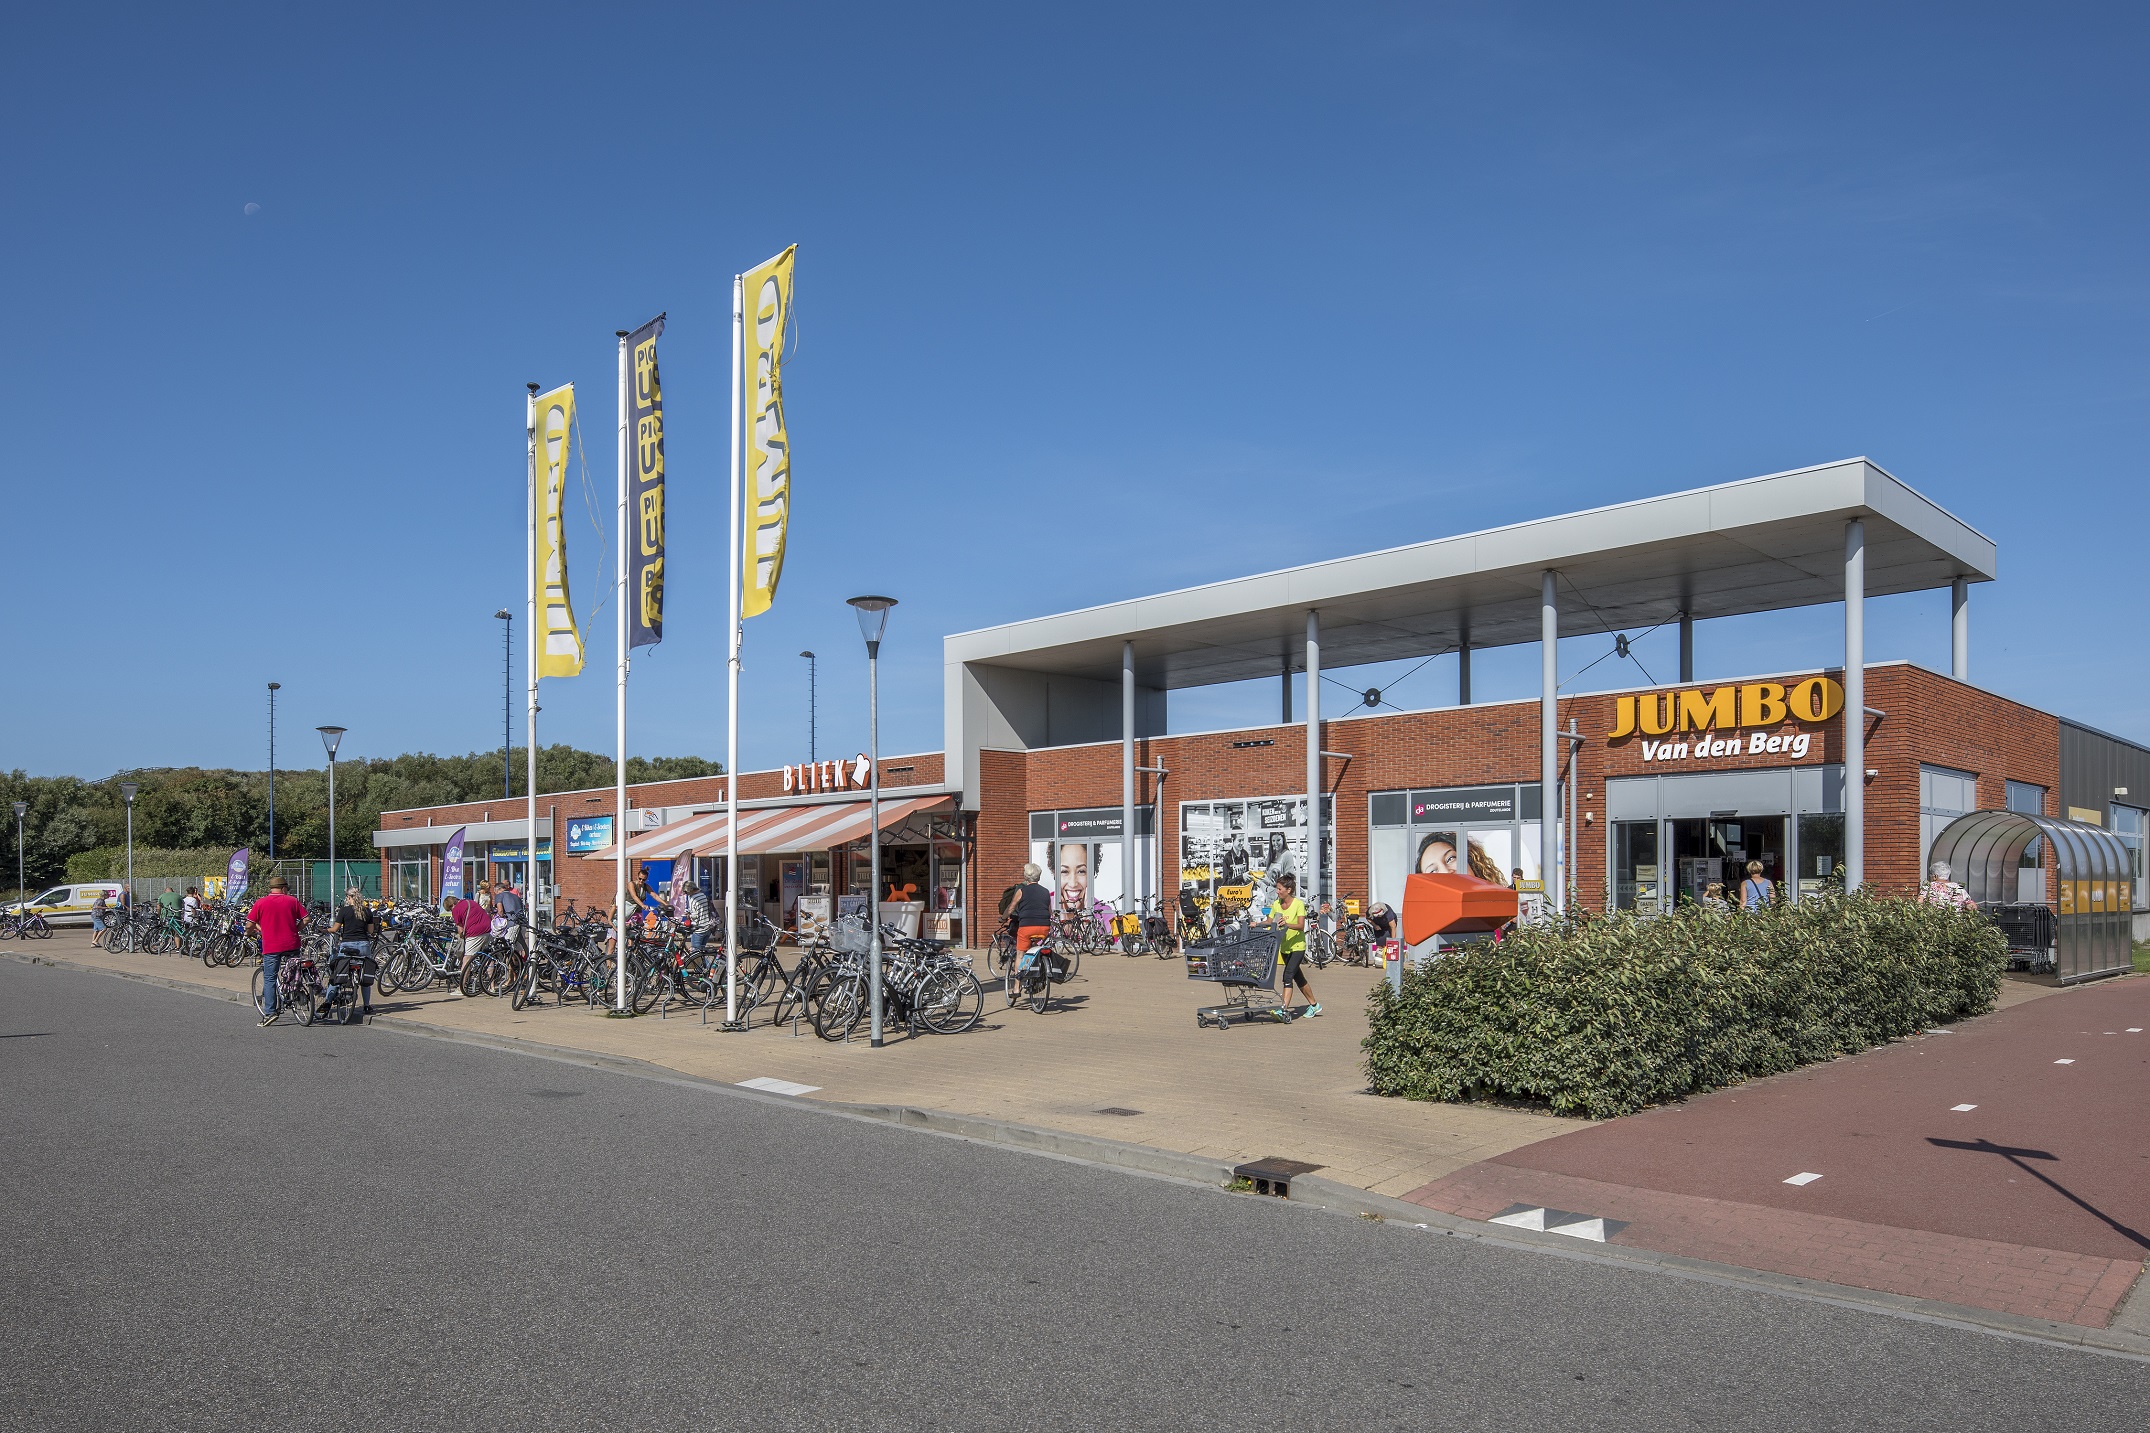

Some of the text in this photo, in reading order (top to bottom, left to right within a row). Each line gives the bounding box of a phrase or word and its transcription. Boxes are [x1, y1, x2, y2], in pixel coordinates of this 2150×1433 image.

[1608, 677, 1845, 738] JUMBO
[1642, 732, 1810, 761] Van den Berg
[783, 759, 847, 791] BLIEK
[1426, 802, 1464, 811] DROGISTERIJ
[1471, 800, 1511, 808] PARFUMERIE
[1519, 881, 1541, 889] JUMBO
